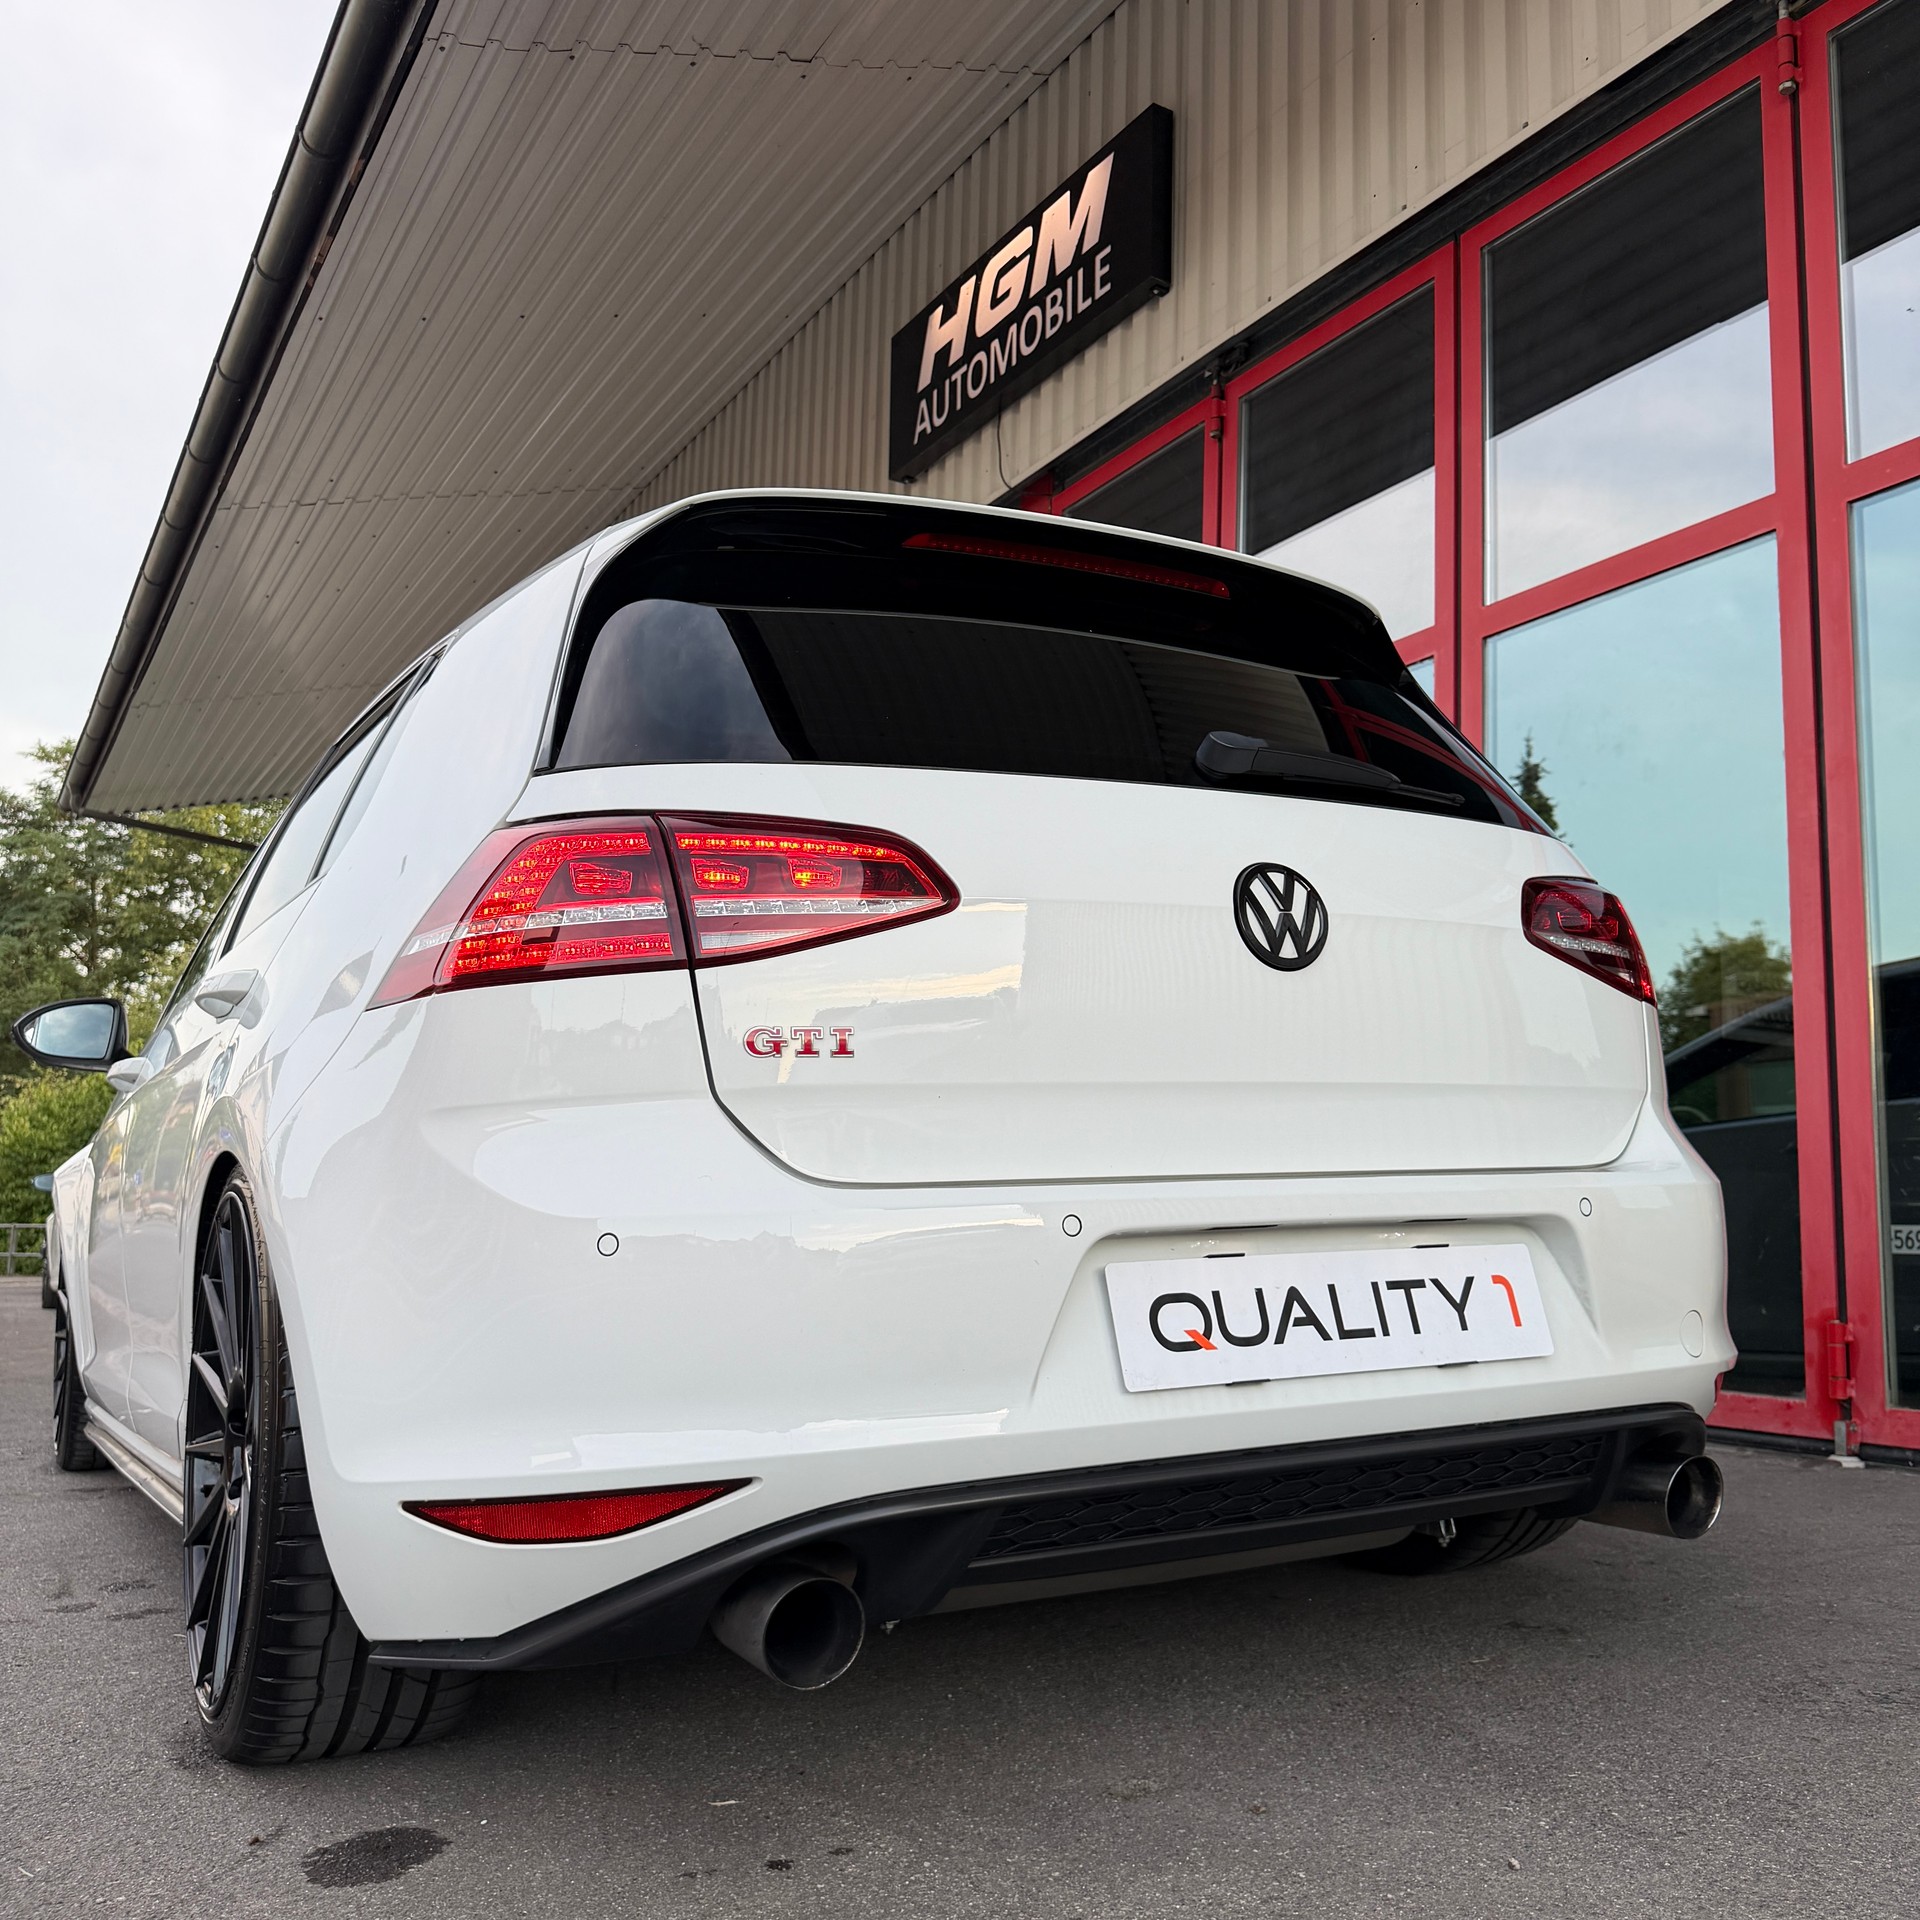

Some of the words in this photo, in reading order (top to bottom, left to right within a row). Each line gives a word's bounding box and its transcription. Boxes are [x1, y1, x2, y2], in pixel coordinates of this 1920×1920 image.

[917, 152, 1114, 394] HGM
[913, 245, 1112, 445] AUTOMOBILE
[743, 1026, 854, 1058] GTI
[1149, 1276, 1475, 1353] QUALITY
[1491, 1274, 1522, 1328] 1
